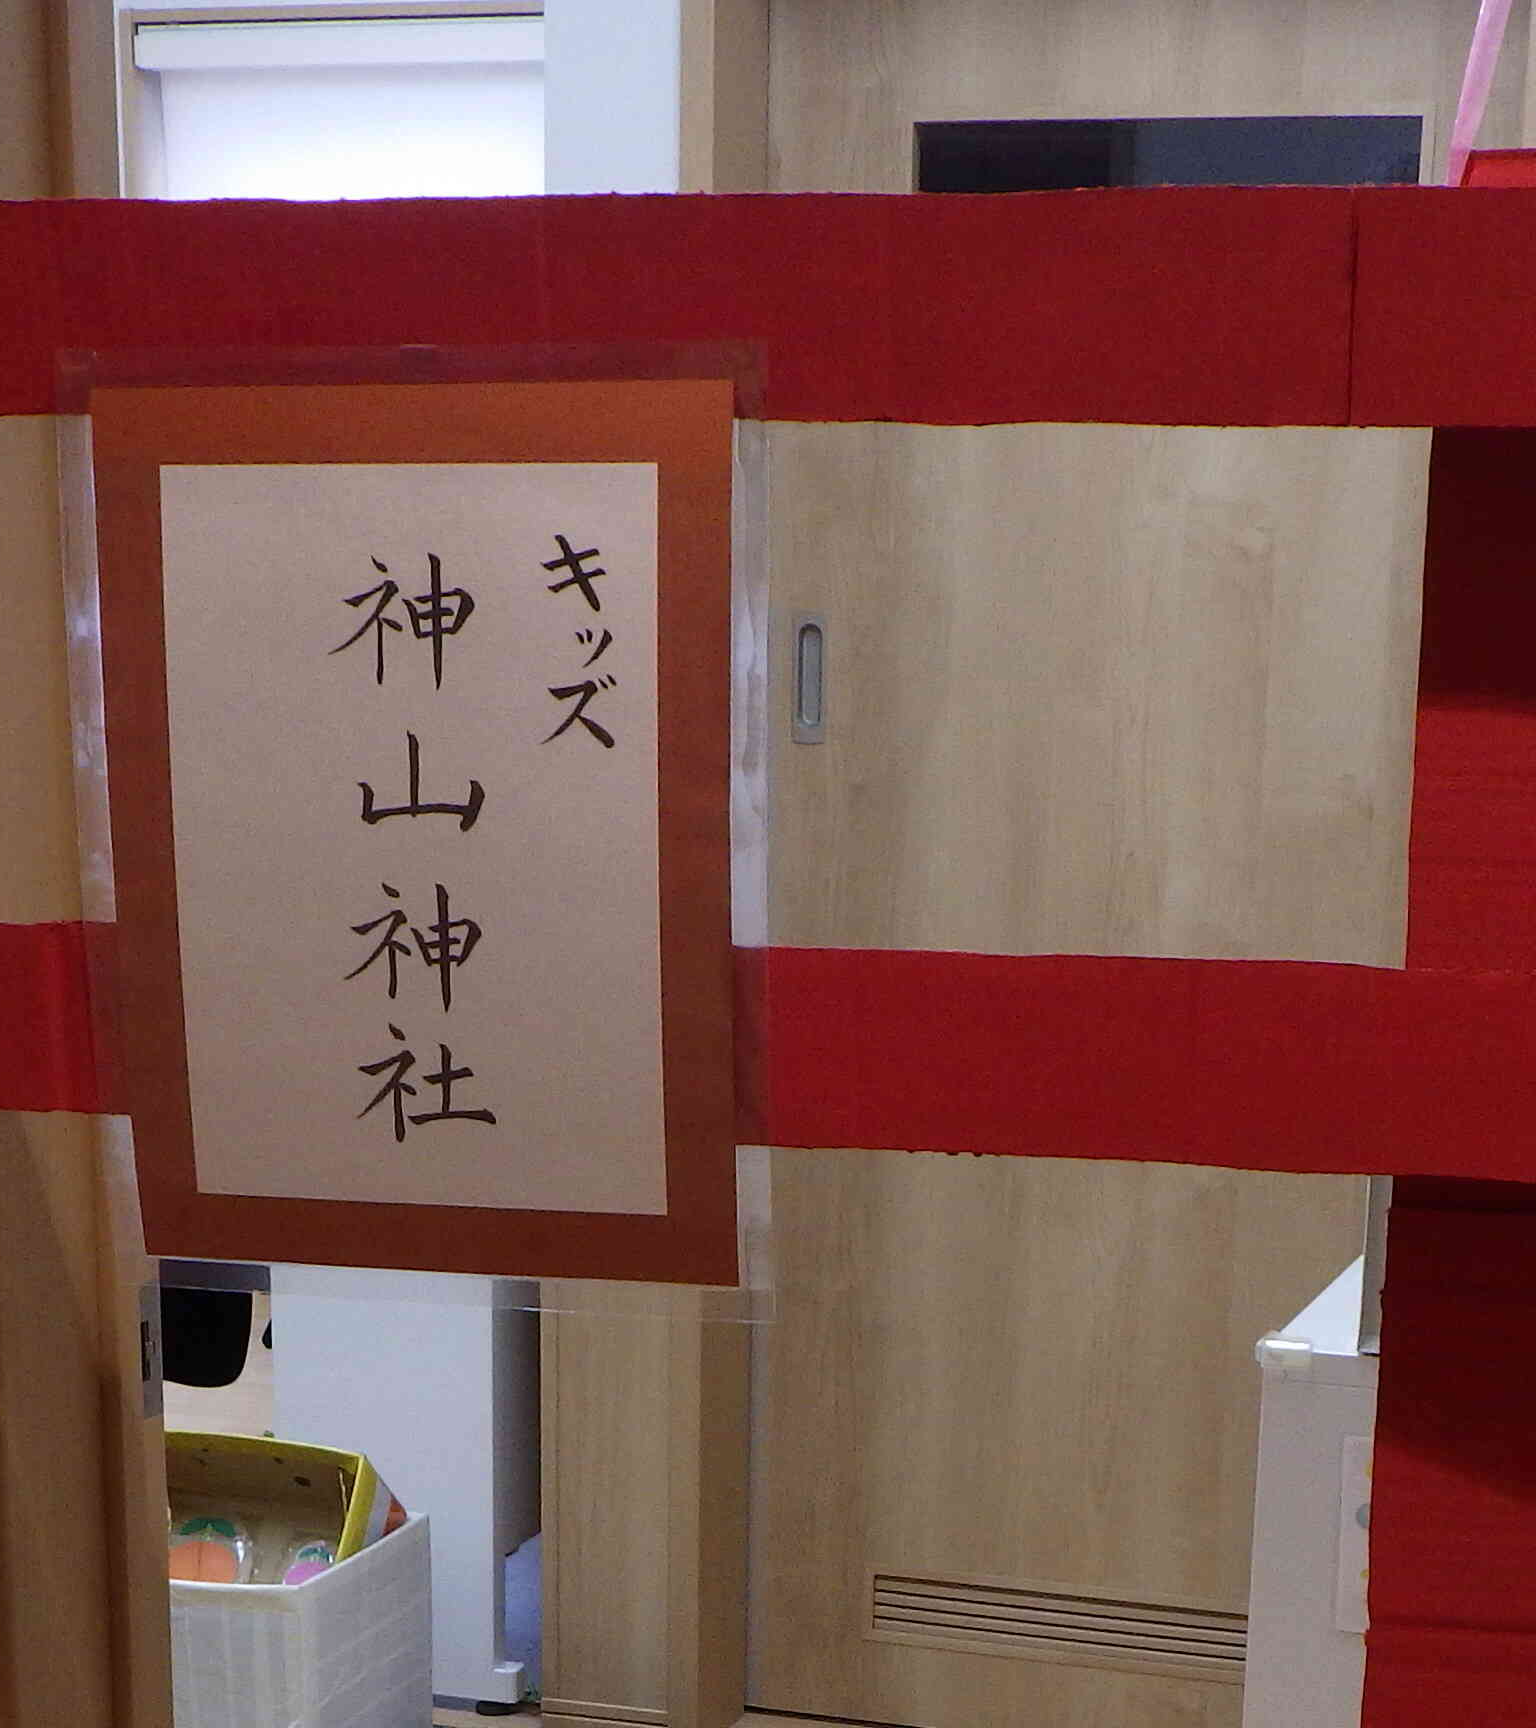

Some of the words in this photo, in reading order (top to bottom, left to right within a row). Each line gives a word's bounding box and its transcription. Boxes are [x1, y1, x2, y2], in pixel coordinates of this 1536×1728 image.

[539, 534, 617, 750] キッズ
[327, 552, 497, 1143] 神山神社
